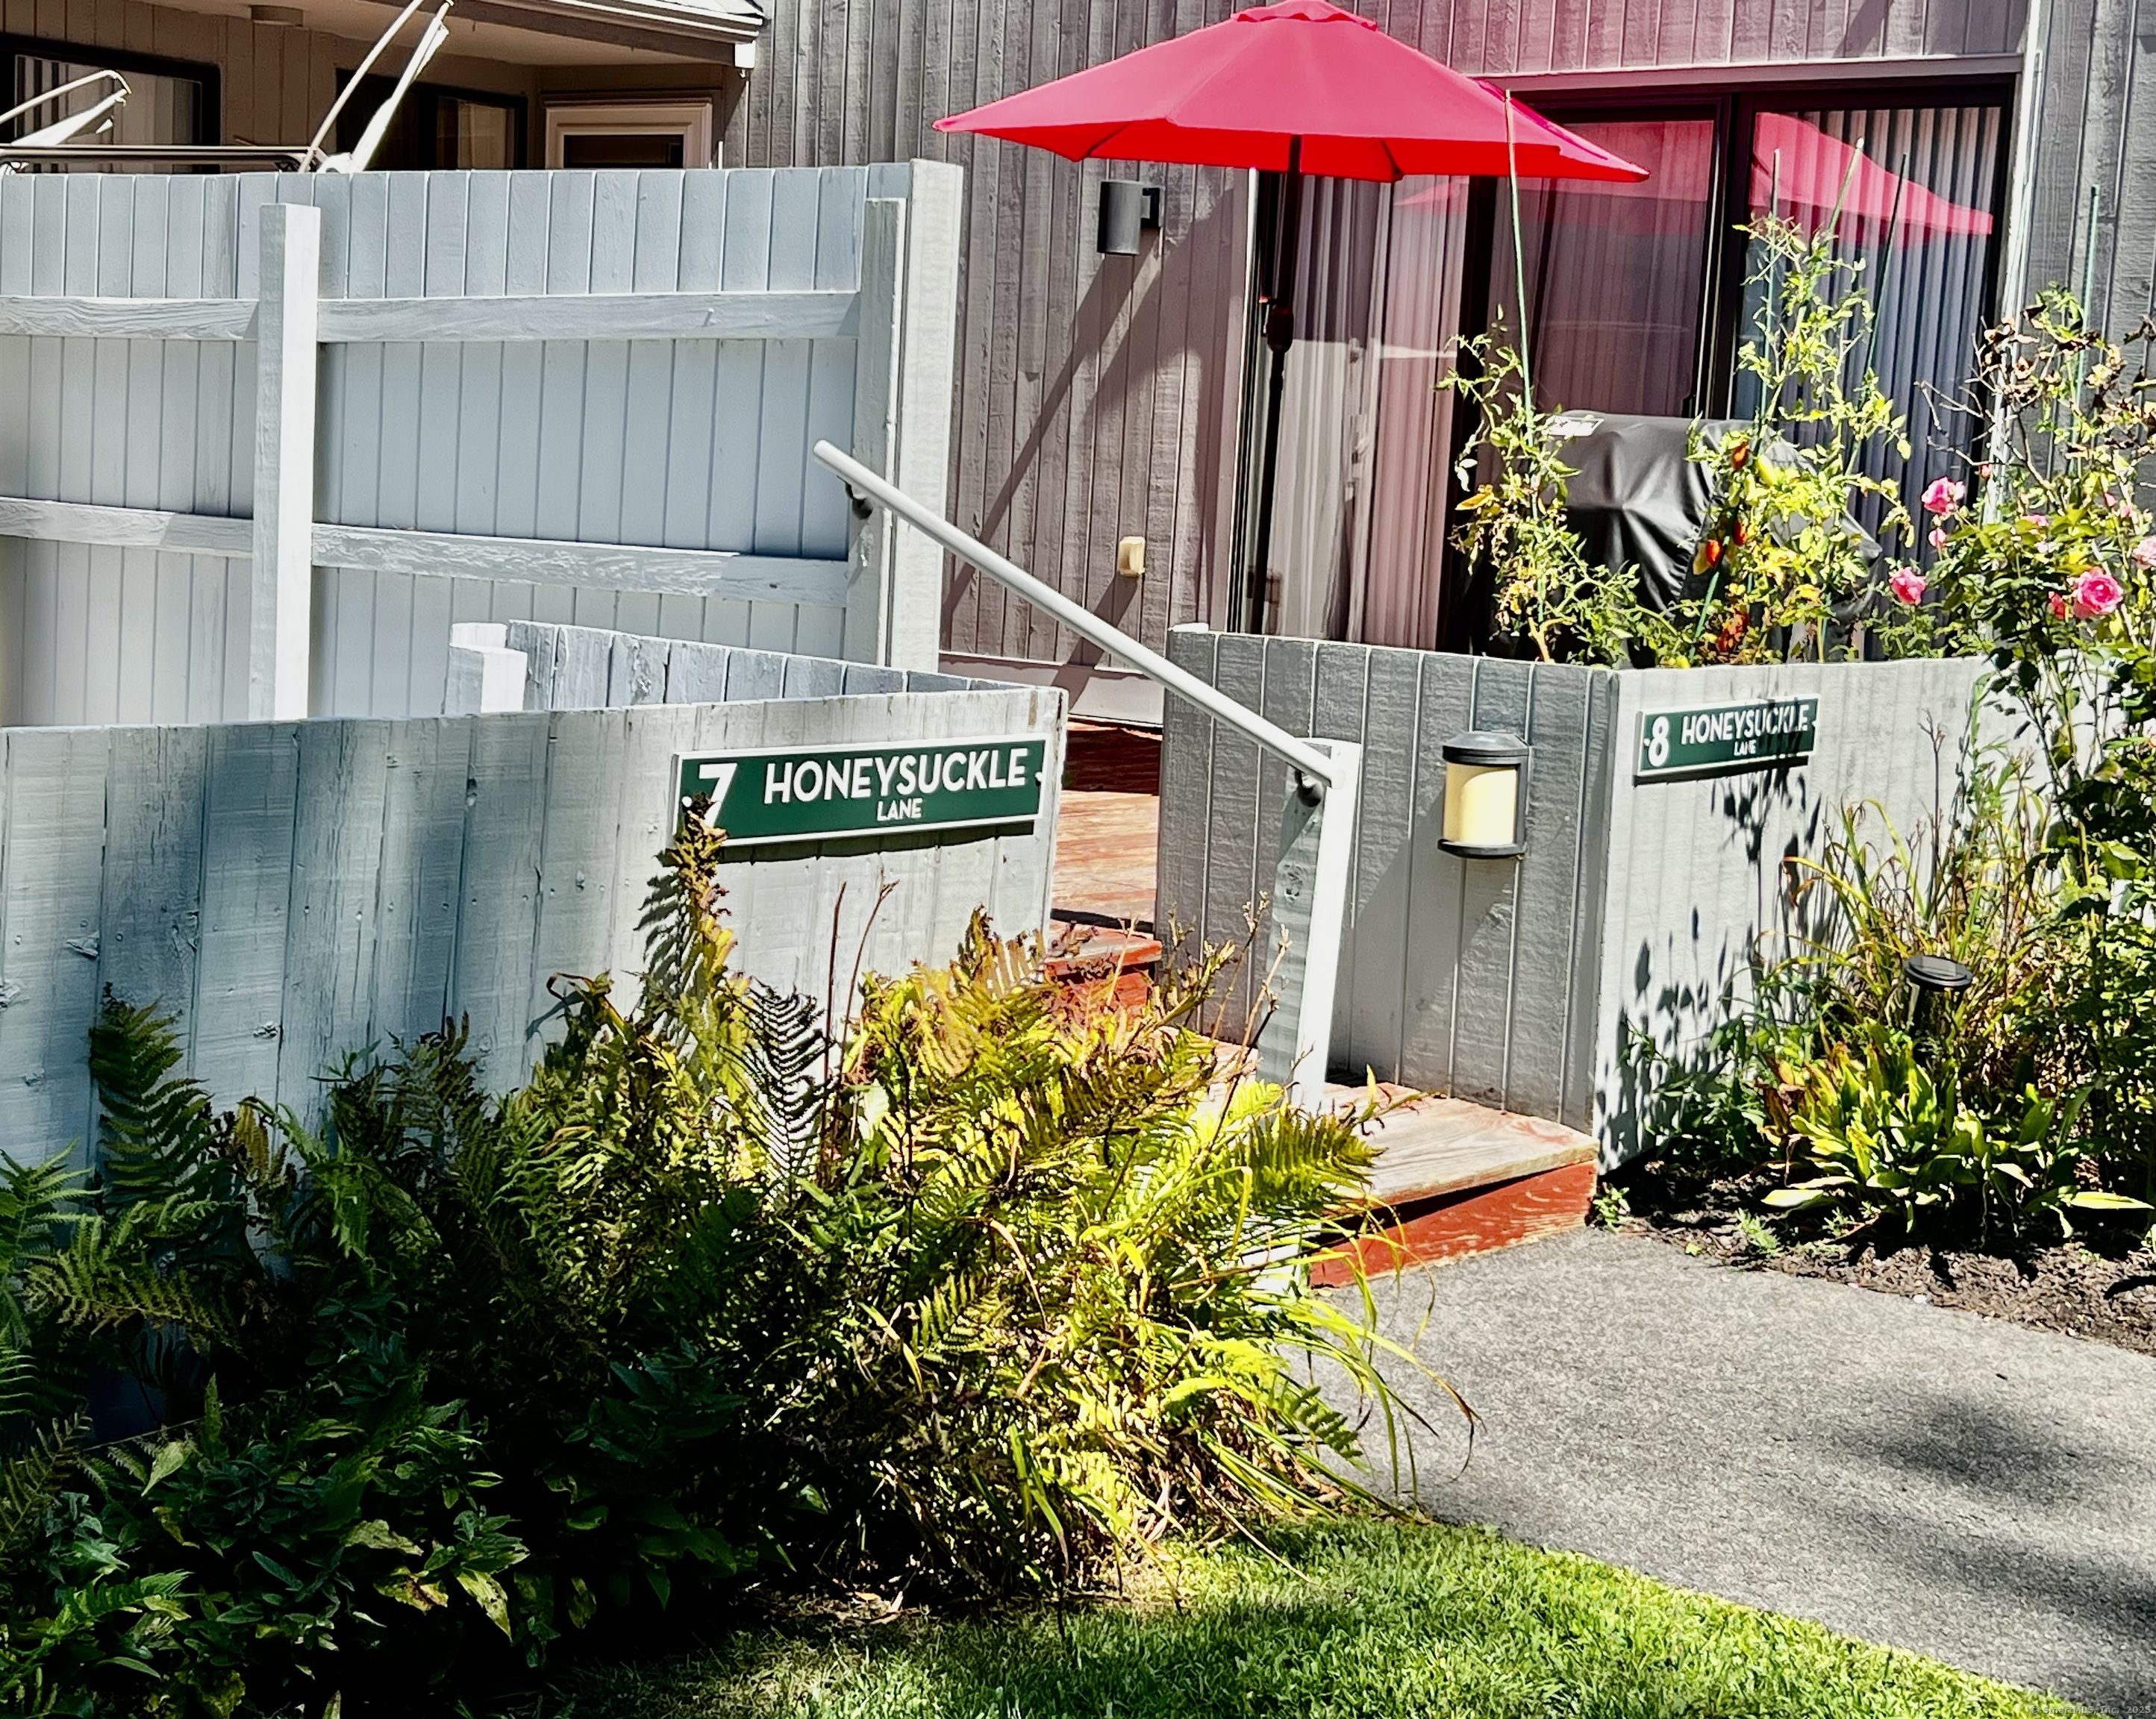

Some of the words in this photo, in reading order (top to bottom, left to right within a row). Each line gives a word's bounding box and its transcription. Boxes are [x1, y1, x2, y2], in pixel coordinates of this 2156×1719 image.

[1648, 716, 1670, 767] 8
[1681, 704, 1810, 745] HONEYSUCKLE
[1734, 739, 1757, 756] LANE
[699, 762, 737, 828] 7
[764, 748, 1029, 804] HONEYSUCKLE
[878, 798, 923, 821] LANE
